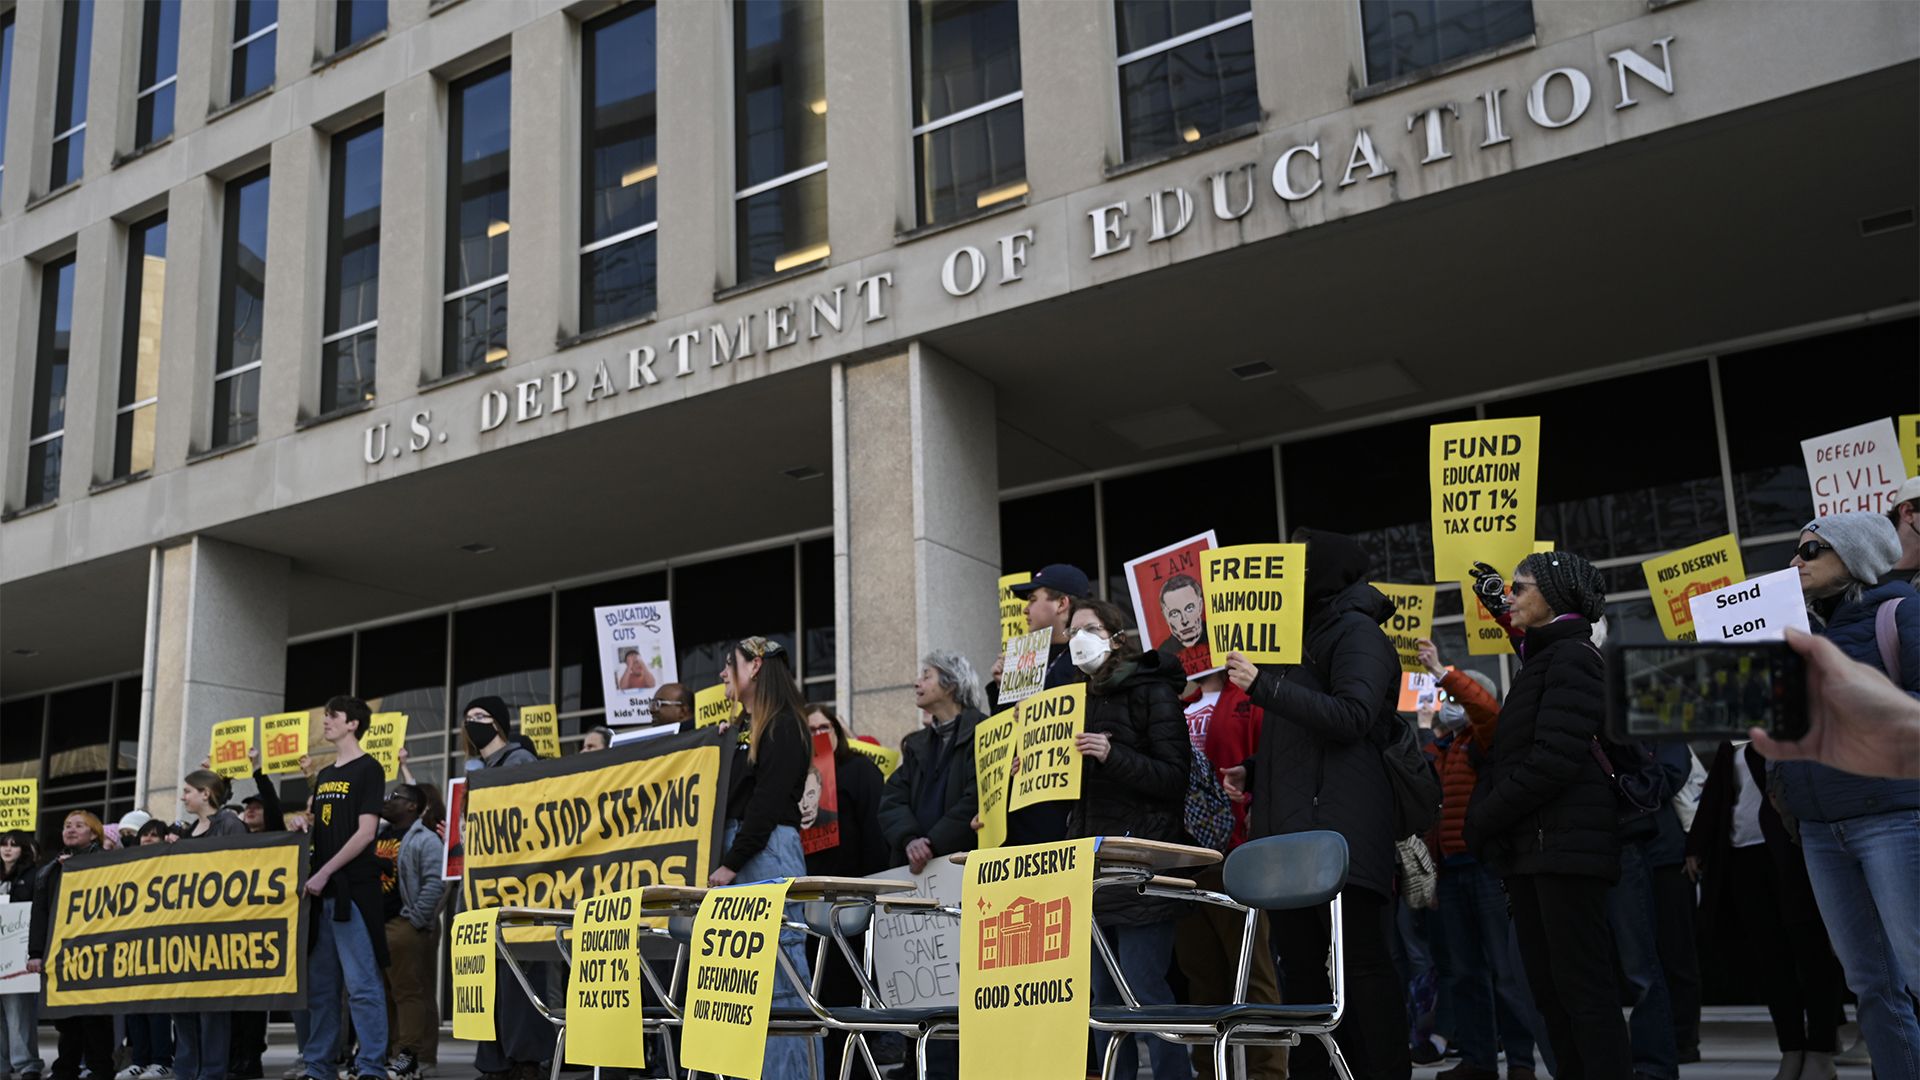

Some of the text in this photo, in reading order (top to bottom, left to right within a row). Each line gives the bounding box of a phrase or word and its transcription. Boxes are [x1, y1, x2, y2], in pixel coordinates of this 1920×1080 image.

[363, 36, 1677, 464] U.S. DEPARTMENT OF EDUCATION
[1443, 434, 1521, 461] FUND
[1816, 440, 1876, 463] DEFEND
[1443, 462, 1520, 486] EDUCATION
[1815, 464, 1891, 497] CIVIL
[1443, 488, 1518, 513] NOT 1%
[1443, 514, 1517, 535] TAX CUTS
[1150, 551, 1194, 581] I AM
[1210, 556, 1285, 583] FREE
[1657, 549, 1728, 583] KIDS DESERVE
[1211, 590, 1283, 614] MAHMOUD
[1387, 595, 1422, 610] UMP:
[1716, 583, 1761, 609] Send
[605, 606, 657, 627] EDUCATION
[1392, 615, 1421, 631] OP
[1722, 617, 1766, 639] Leon
[613, 627, 636, 641] CUTS
[1008, 622, 1023, 637] 1%
[1213, 623, 1281, 653] KHALIL
[1478, 628, 1502, 640] GOOD
[1677, 629, 1696, 641] GOO
[525, 711, 552, 724] FUND
[614, 708, 635, 718] kids'
[1024, 695, 1075, 726] FUND
[225, 724, 247, 735] DESERVE
[276, 718, 301, 729] DESERVE
[368, 723, 394, 736] FUND
[1023, 721, 1073, 750] EDUCATION
[366, 738, 393, 750] EDUCATION
[979, 722, 1012, 753] FUND
[372, 751, 392, 761] OT 1%
[979, 743, 1009, 773] EDUCATION
[1022, 746, 1070, 775] NOT 1%
[981, 765, 1004, 796] NOT 1%
[1020, 772, 1069, 796] TAX CUTS
[17, 808, 30, 817] 1%
[468, 773, 701, 856] TRUMP: STOP STEALING
[977, 846, 1077, 885] KIDS DESERVE
[475, 855, 688, 910] FROM KIDS
[906, 874, 937, 899] AVE
[66, 867, 287, 925] FUND SCHOOLS
[585, 896, 631, 923] FUND
[711, 897, 772, 921] TRUMP:
[455, 921, 488, 945] FREE
[876, 904, 960, 940] CHILDREN
[581, 928, 630, 952] EDUCATION
[701, 928, 764, 959] STOP
[903, 934, 948, 965] SAVE
[62, 931, 280, 982] NOT BILLIONAIRES
[455, 954, 485, 976] MAHMOUD
[579, 958, 629, 983] NOT 1%
[697, 966, 759, 995] DEFUNDING
[456, 985, 485, 1014] KHALIL
[579, 990, 630, 1009] TAX CUTS
[886, 978, 899, 1007] THE
[974, 978, 1074, 1010] GOOD SCHOOLS
[694, 999, 754, 1026] OUR FUTURES
